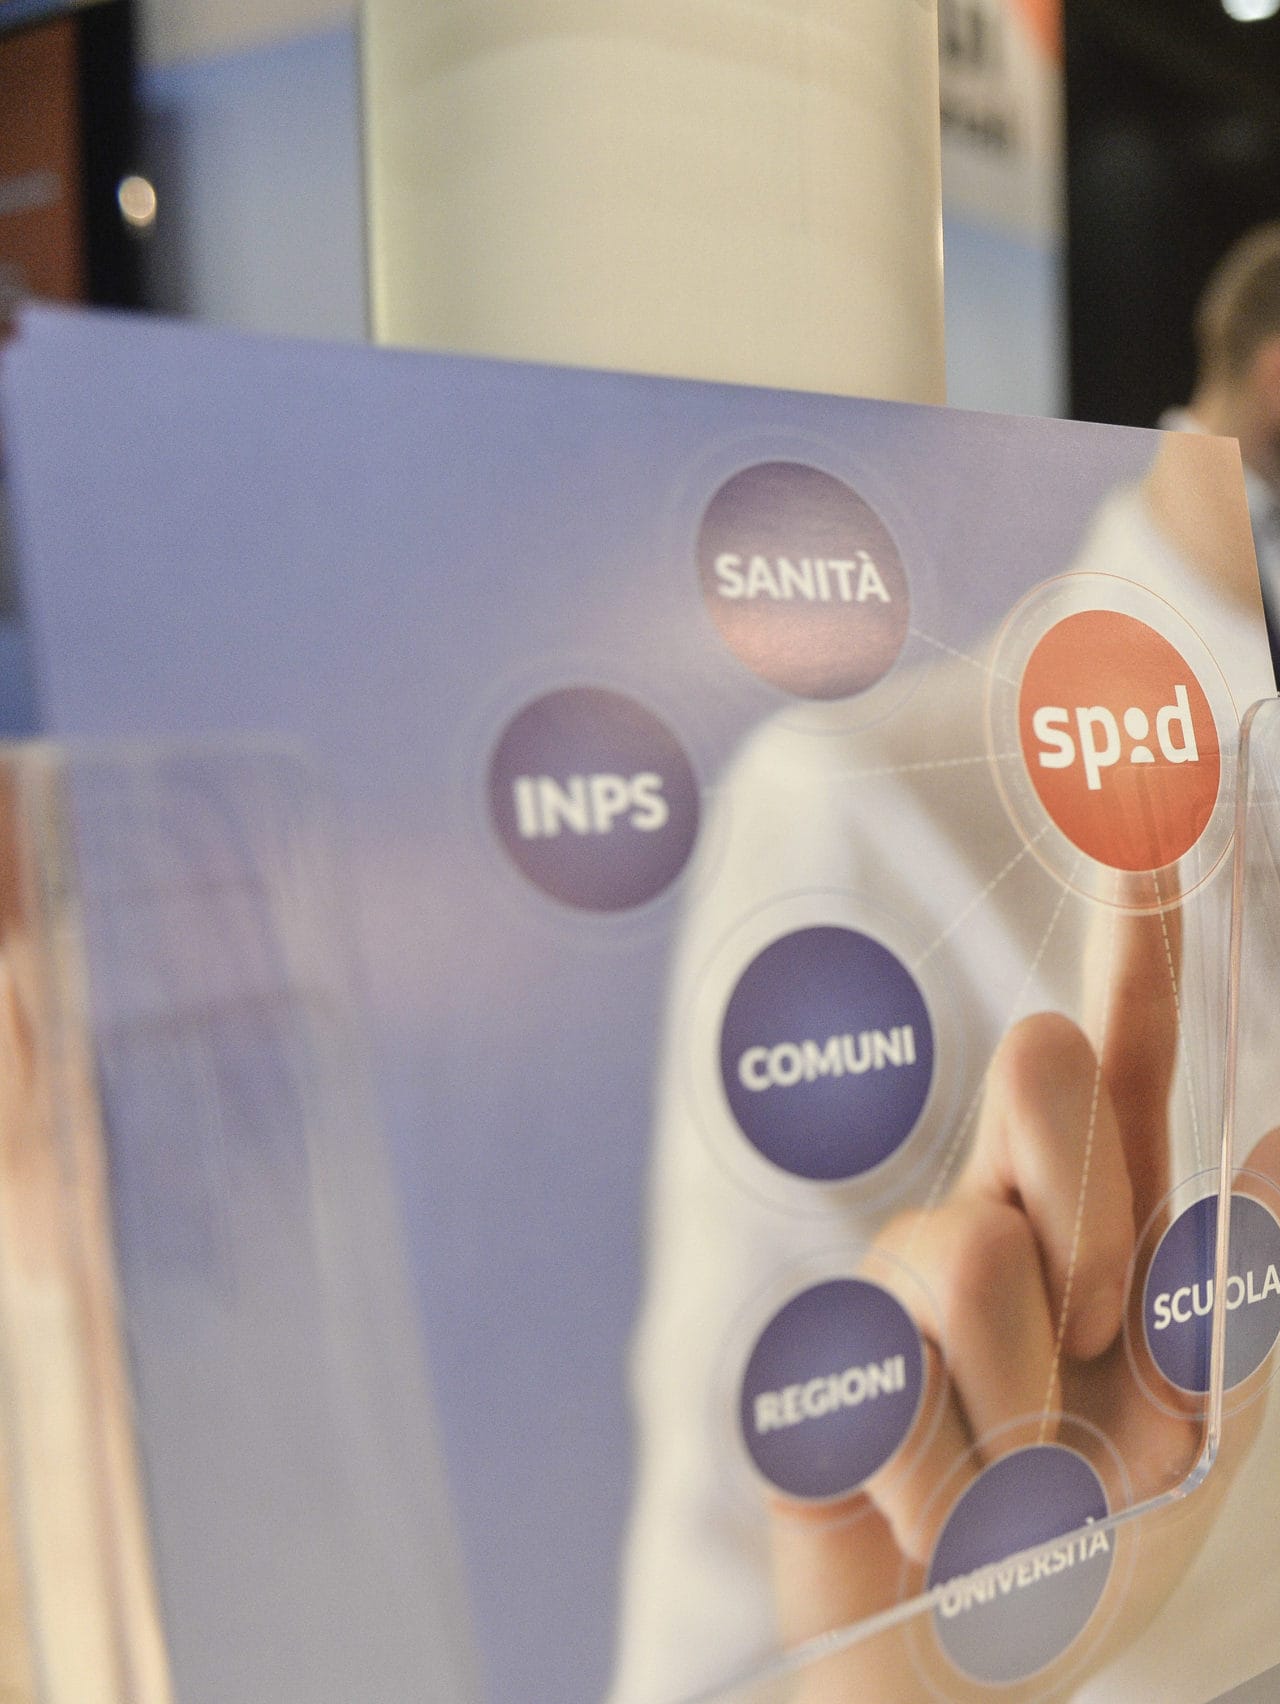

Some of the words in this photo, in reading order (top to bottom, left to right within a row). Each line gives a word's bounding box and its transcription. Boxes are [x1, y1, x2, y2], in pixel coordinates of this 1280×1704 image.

[714, 550, 891, 603] SANITÀ
[515, 772, 668, 835] INPS
[739, 1025, 916, 1092] COMUNI
[754, 1356, 905, 1432] REGIONI
